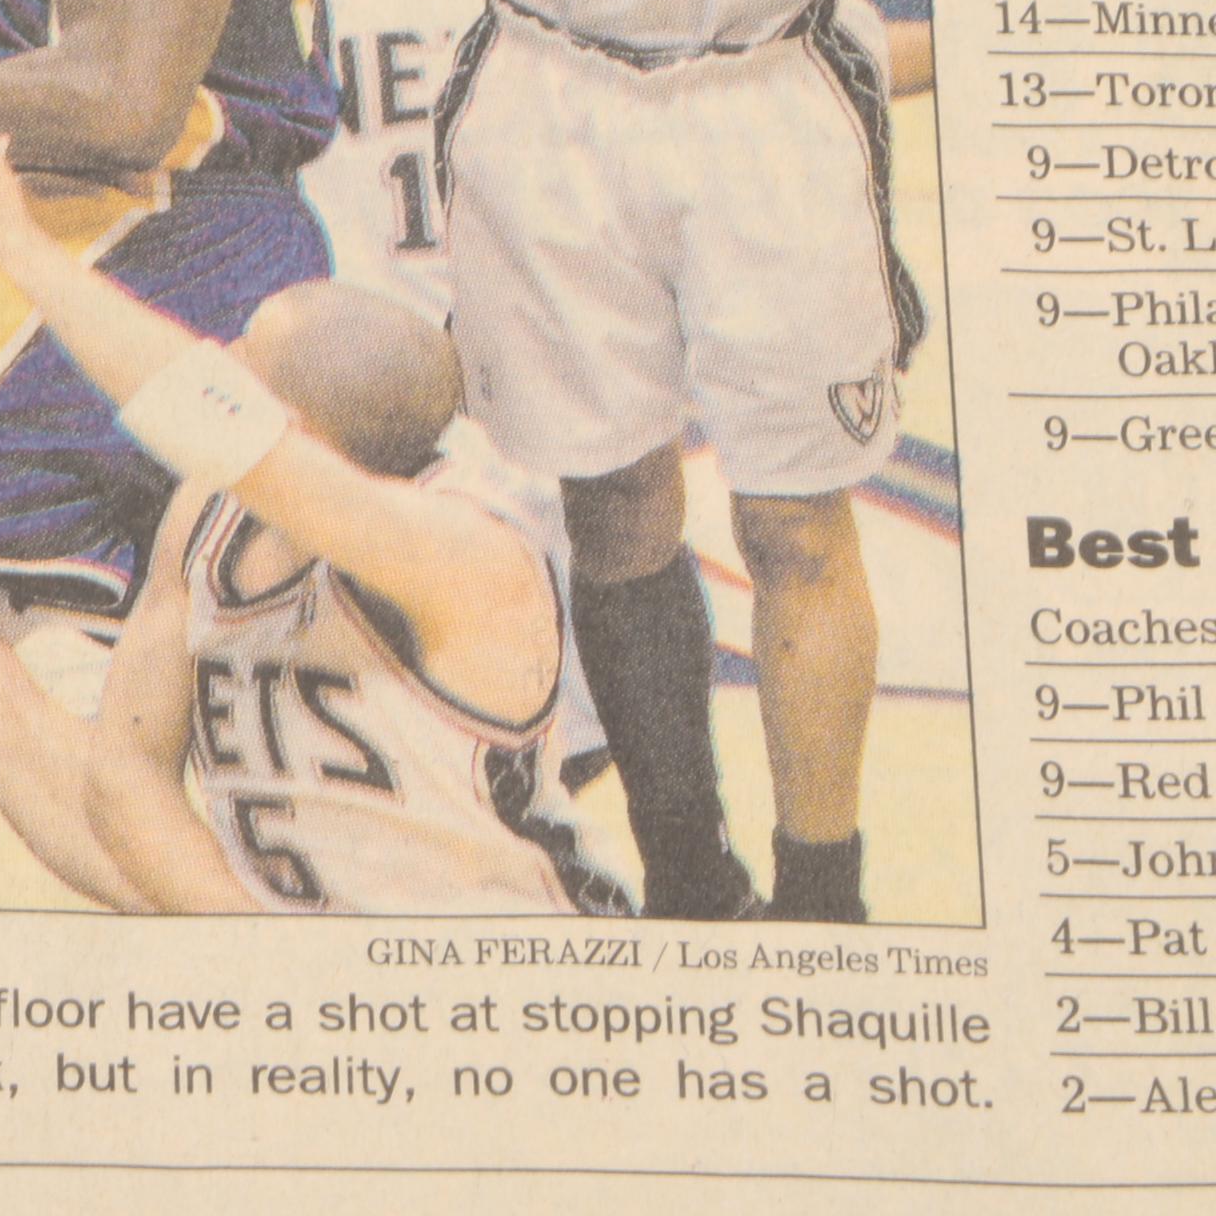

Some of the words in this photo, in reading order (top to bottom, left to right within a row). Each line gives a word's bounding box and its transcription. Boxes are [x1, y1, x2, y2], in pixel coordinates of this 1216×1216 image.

[1026, 516, 1200, 569] Best
[367, 939, 463, 966] GINA
[476, 939, 640, 966] FERAZZI
[680, 942, 737, 969] Los
[750, 945, 881, 976] Angeles
[886, 947, 989, 977] Times
[128, 992, 240, 1030] have
[265, 1002, 292, 1030] a
[319, 993, 428, 1032] shot
[451, 995, 499, 1032] at
[523, 995, 738, 1045] stopping
[761, 997, 990, 1050] Shaquille
[57, 1053, 137, 1093] but
[174, 1055, 212, 1094] in
[252, 1056, 414, 1104] reality,
[454, 1067, 513, 1096] no
[550, 1067, 640, 1098] one
[678, 1060, 768, 1100] has
[804, 1072, 831, 1102] a
[870, 1066, 992, 1108] shot.
